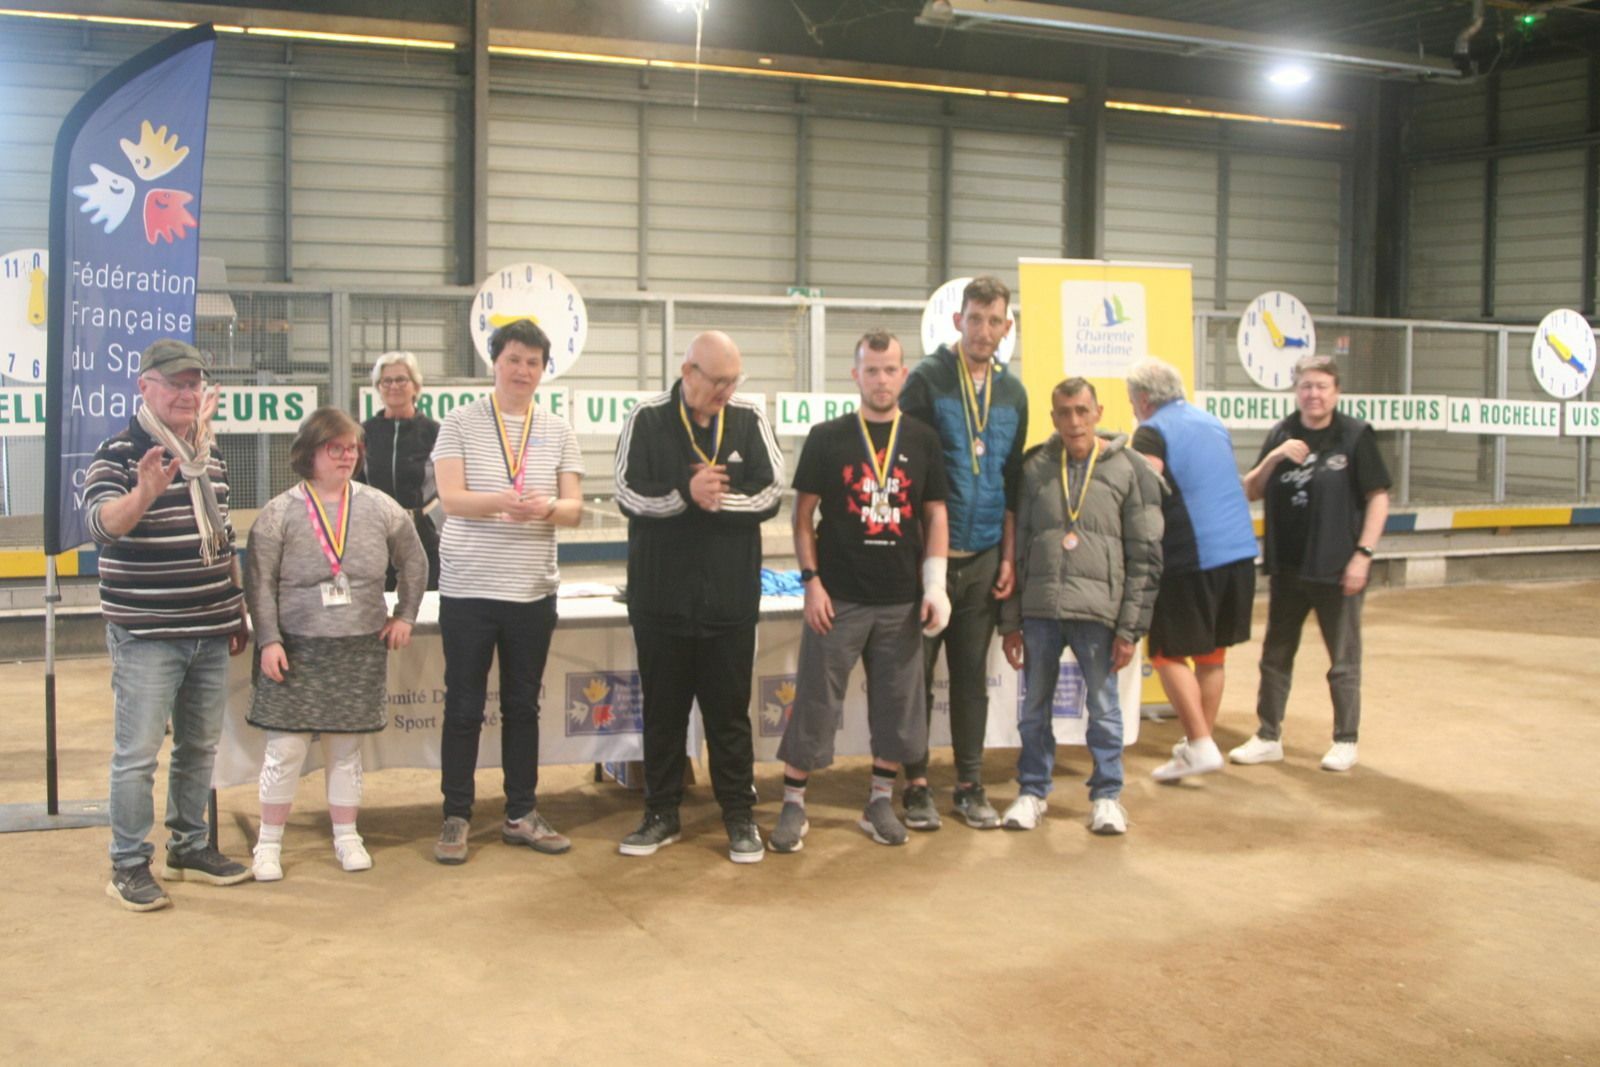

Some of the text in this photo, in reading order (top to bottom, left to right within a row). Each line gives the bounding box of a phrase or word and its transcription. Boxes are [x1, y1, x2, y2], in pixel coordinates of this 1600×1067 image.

[4, 257, 19, 279] 11
[72, 260, 196, 296] Fédération
[526, 265, 533, 283] 0
[501, 271, 512, 289] 11
[480, 291, 493, 310] 10
[568, 293, 574, 312] 2
[72, 300, 192, 335] Française
[573, 314, 580, 332] 3
[1075, 328, 1135, 342] Charente
[1075, 343, 1132, 356] Maritime
[8, 352, 16, 373] 7
[32, 358, 40, 379] 6
[72, 342, 141, 379] du Sp
[212, 392, 304, 421] EURS
[782, 399, 810, 424] LA
[1206, 396, 1296, 420] ROCHELL
[1451, 402, 1557, 427] LA ROCHELLE
[394, 713, 437, 733] Sport
